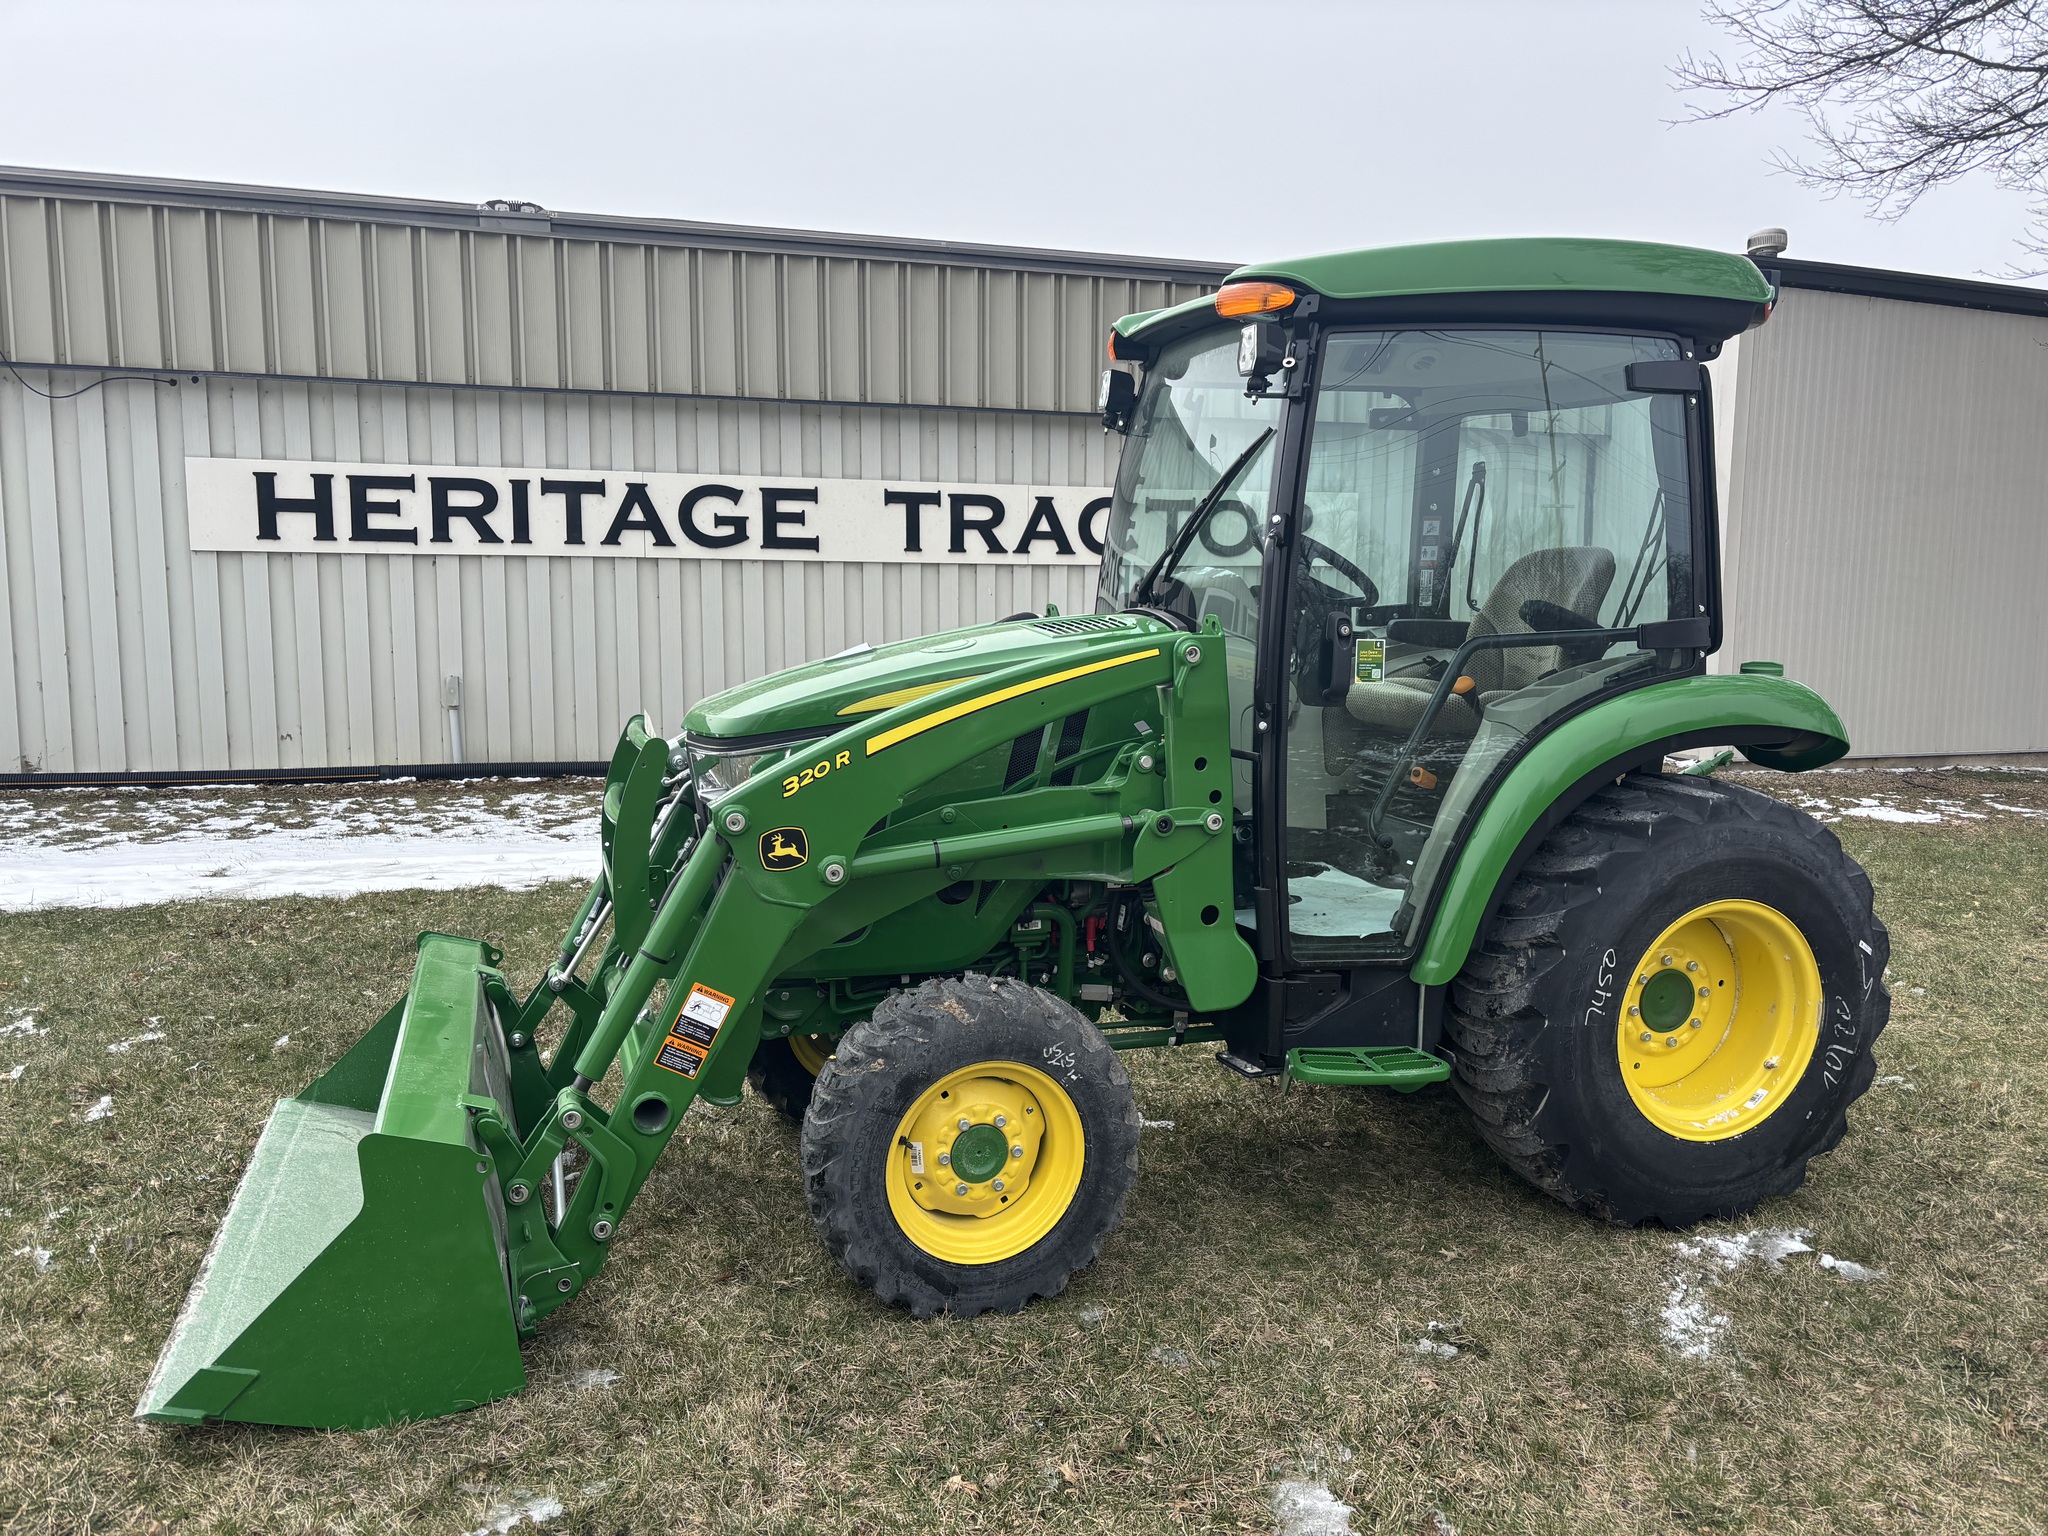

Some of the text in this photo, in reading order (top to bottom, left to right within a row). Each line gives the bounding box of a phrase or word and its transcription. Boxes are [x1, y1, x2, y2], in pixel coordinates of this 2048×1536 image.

[252, 471, 820, 554] HERITAGE
[782, 750, 851, 798] 320 R
[703, 989, 730, 1003] WARNING
[677, 1042, 703, 1056] WARNING
